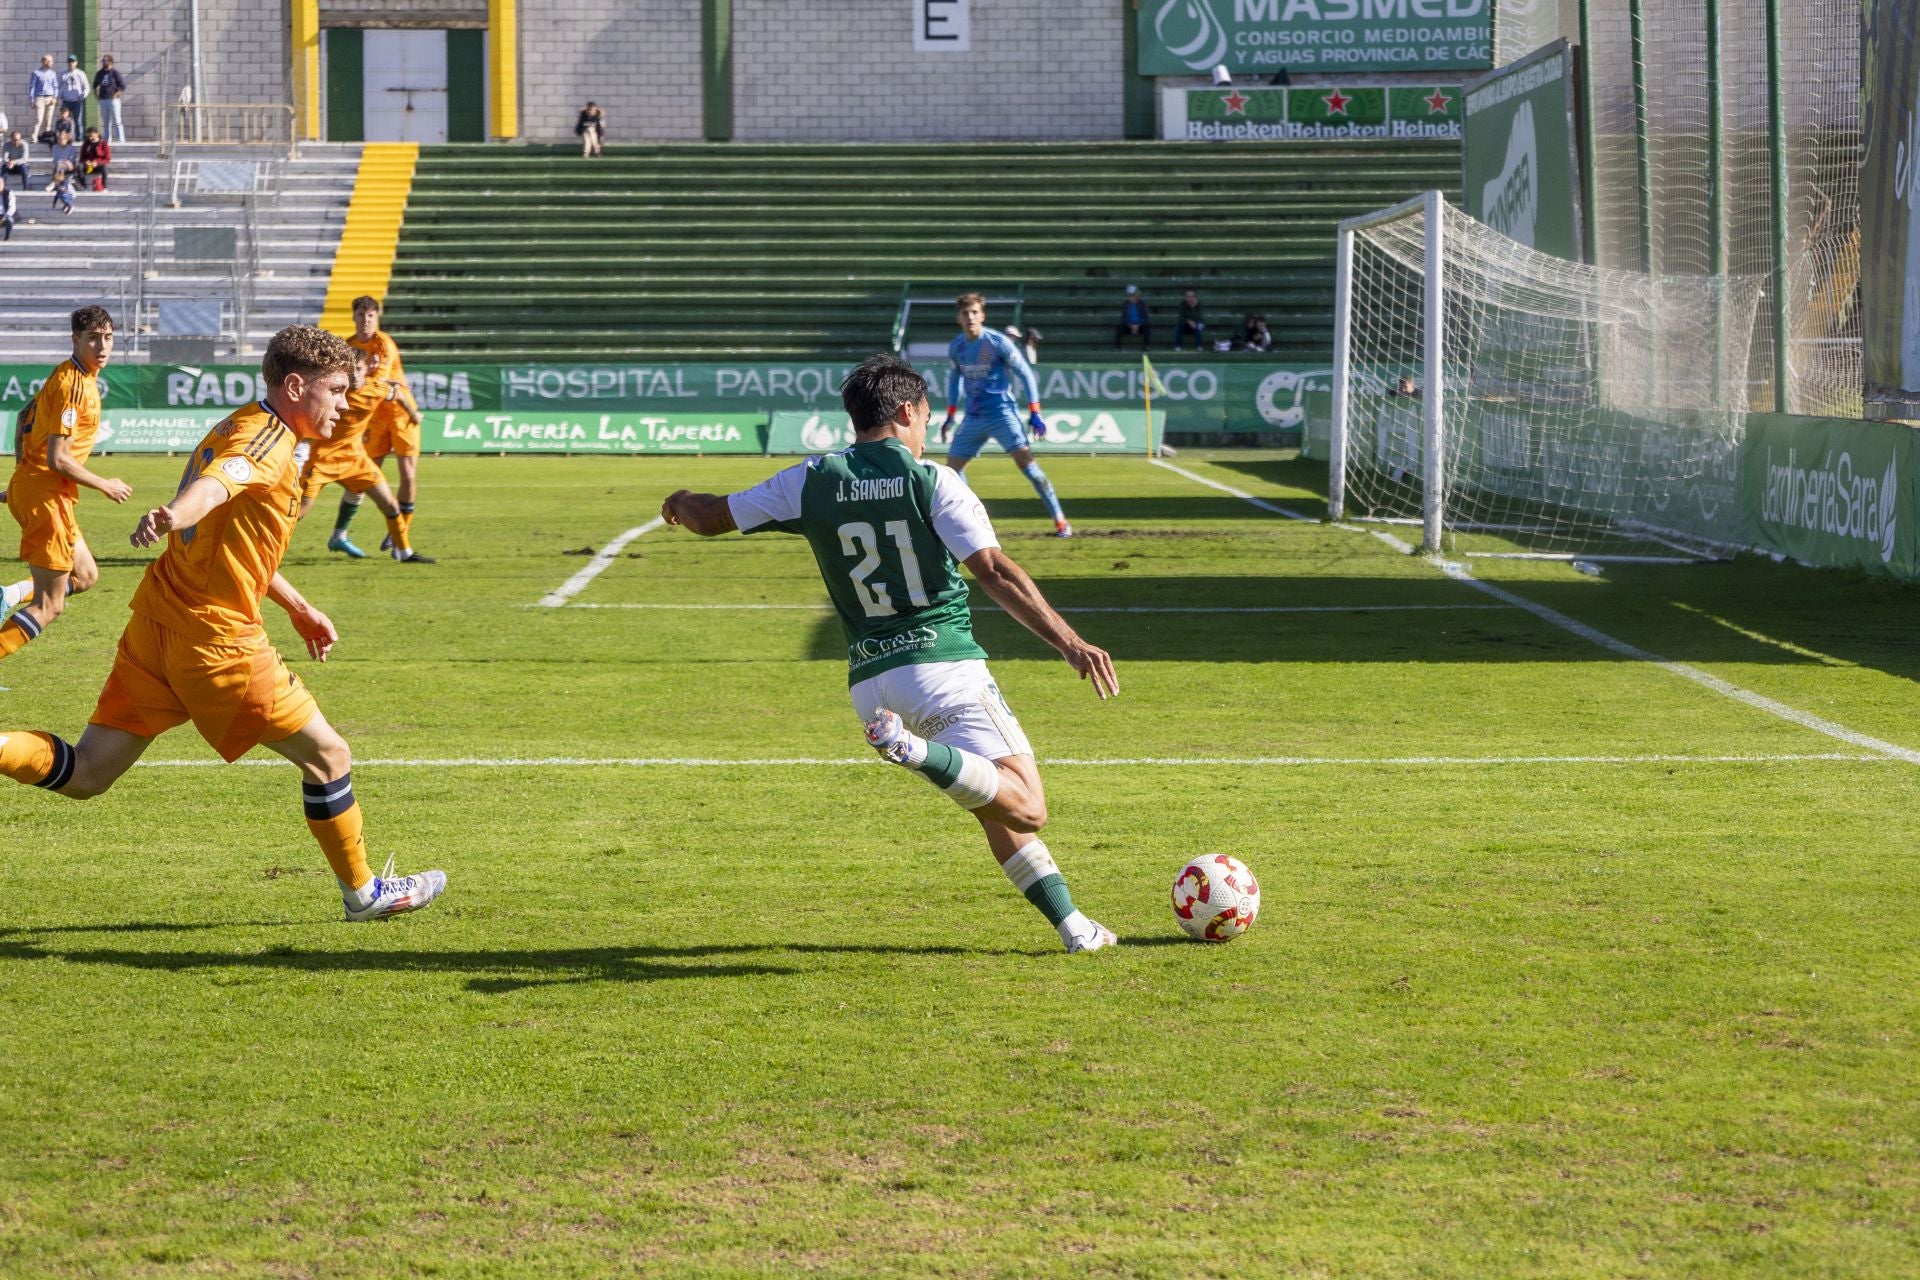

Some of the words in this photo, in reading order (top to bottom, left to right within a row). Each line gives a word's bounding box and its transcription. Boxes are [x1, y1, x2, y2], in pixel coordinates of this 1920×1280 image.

[1235, 29, 1355, 46] CONSORCIO
[1235, 51, 1247, 64] Y
[1252, 49, 1316, 64] AGUAS
[1321, 47, 1419, 63] PROVINCIA
[1425, 47, 1449, 61] DE
[1188, 120, 1284, 139] Heineken
[1287, 121, 1389, 139] Heineken
[1391, 119, 1462, 138] Heinek
[508, 367, 700, 399] HOSPITAL
[715, 367, 847, 402] PARQU
[120, 417, 200, 429] MANUEL
[836, 480, 847, 502] J.
[850, 476, 904, 502] SANCHO
[837, 519, 931, 618] 21
